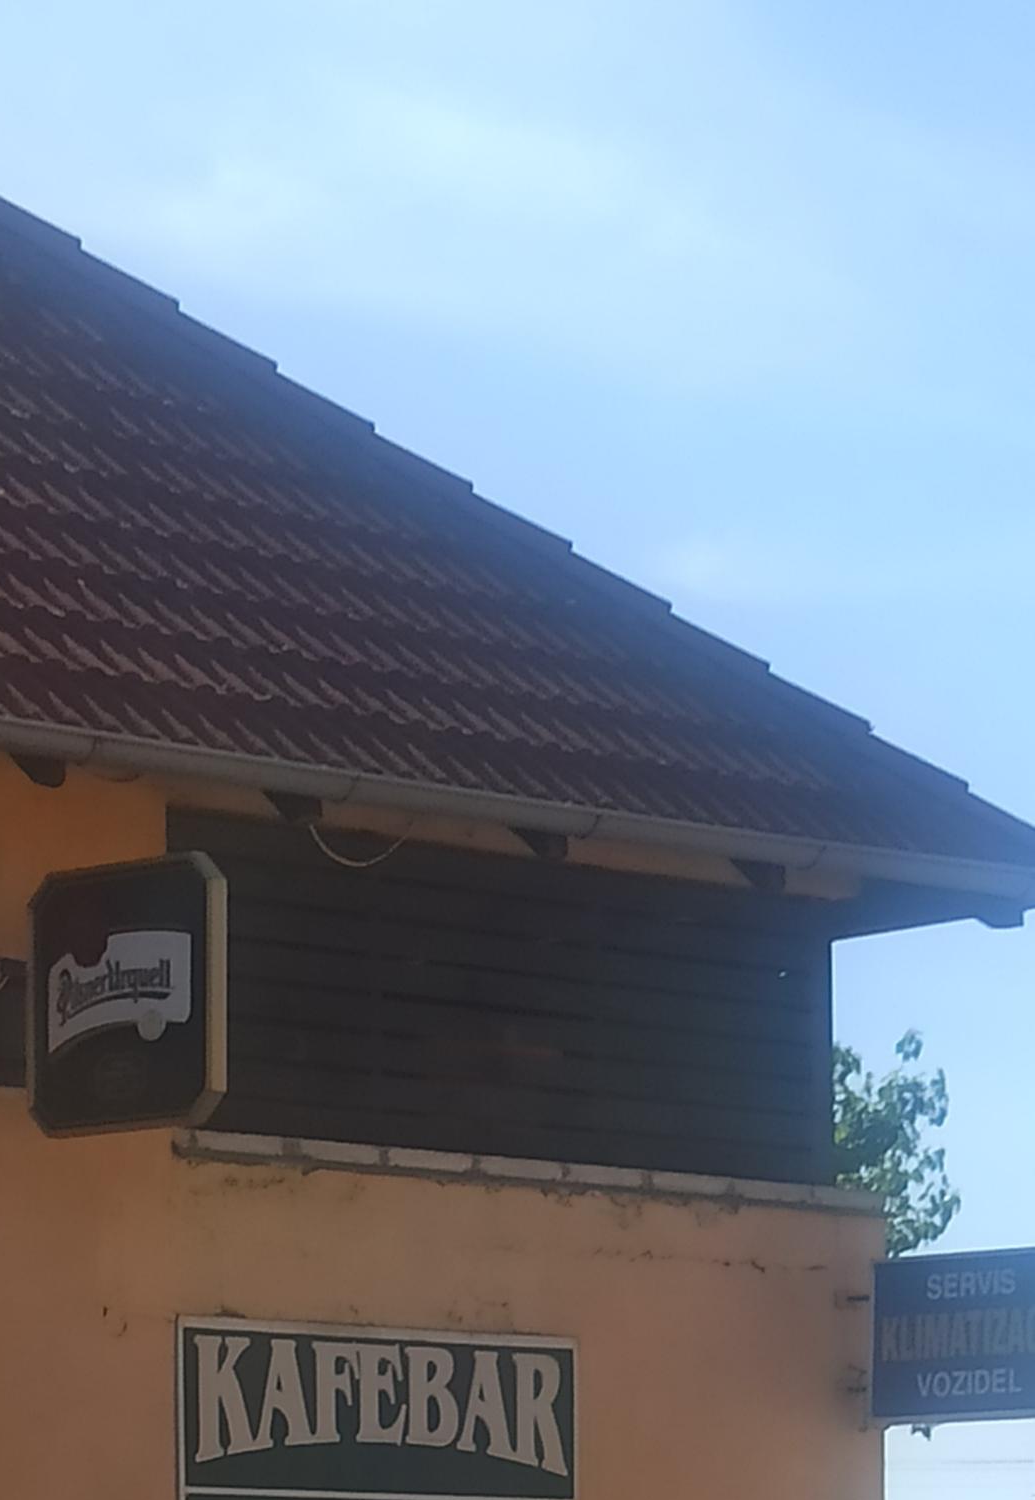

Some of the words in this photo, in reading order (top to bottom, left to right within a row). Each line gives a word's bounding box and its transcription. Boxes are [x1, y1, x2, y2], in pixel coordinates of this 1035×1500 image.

[926, 1268, 1016, 1300] SERVIS
[916, 1368, 1022, 1398] VOZIDEL
[193, 1334, 568, 1477] KAFEBAR
